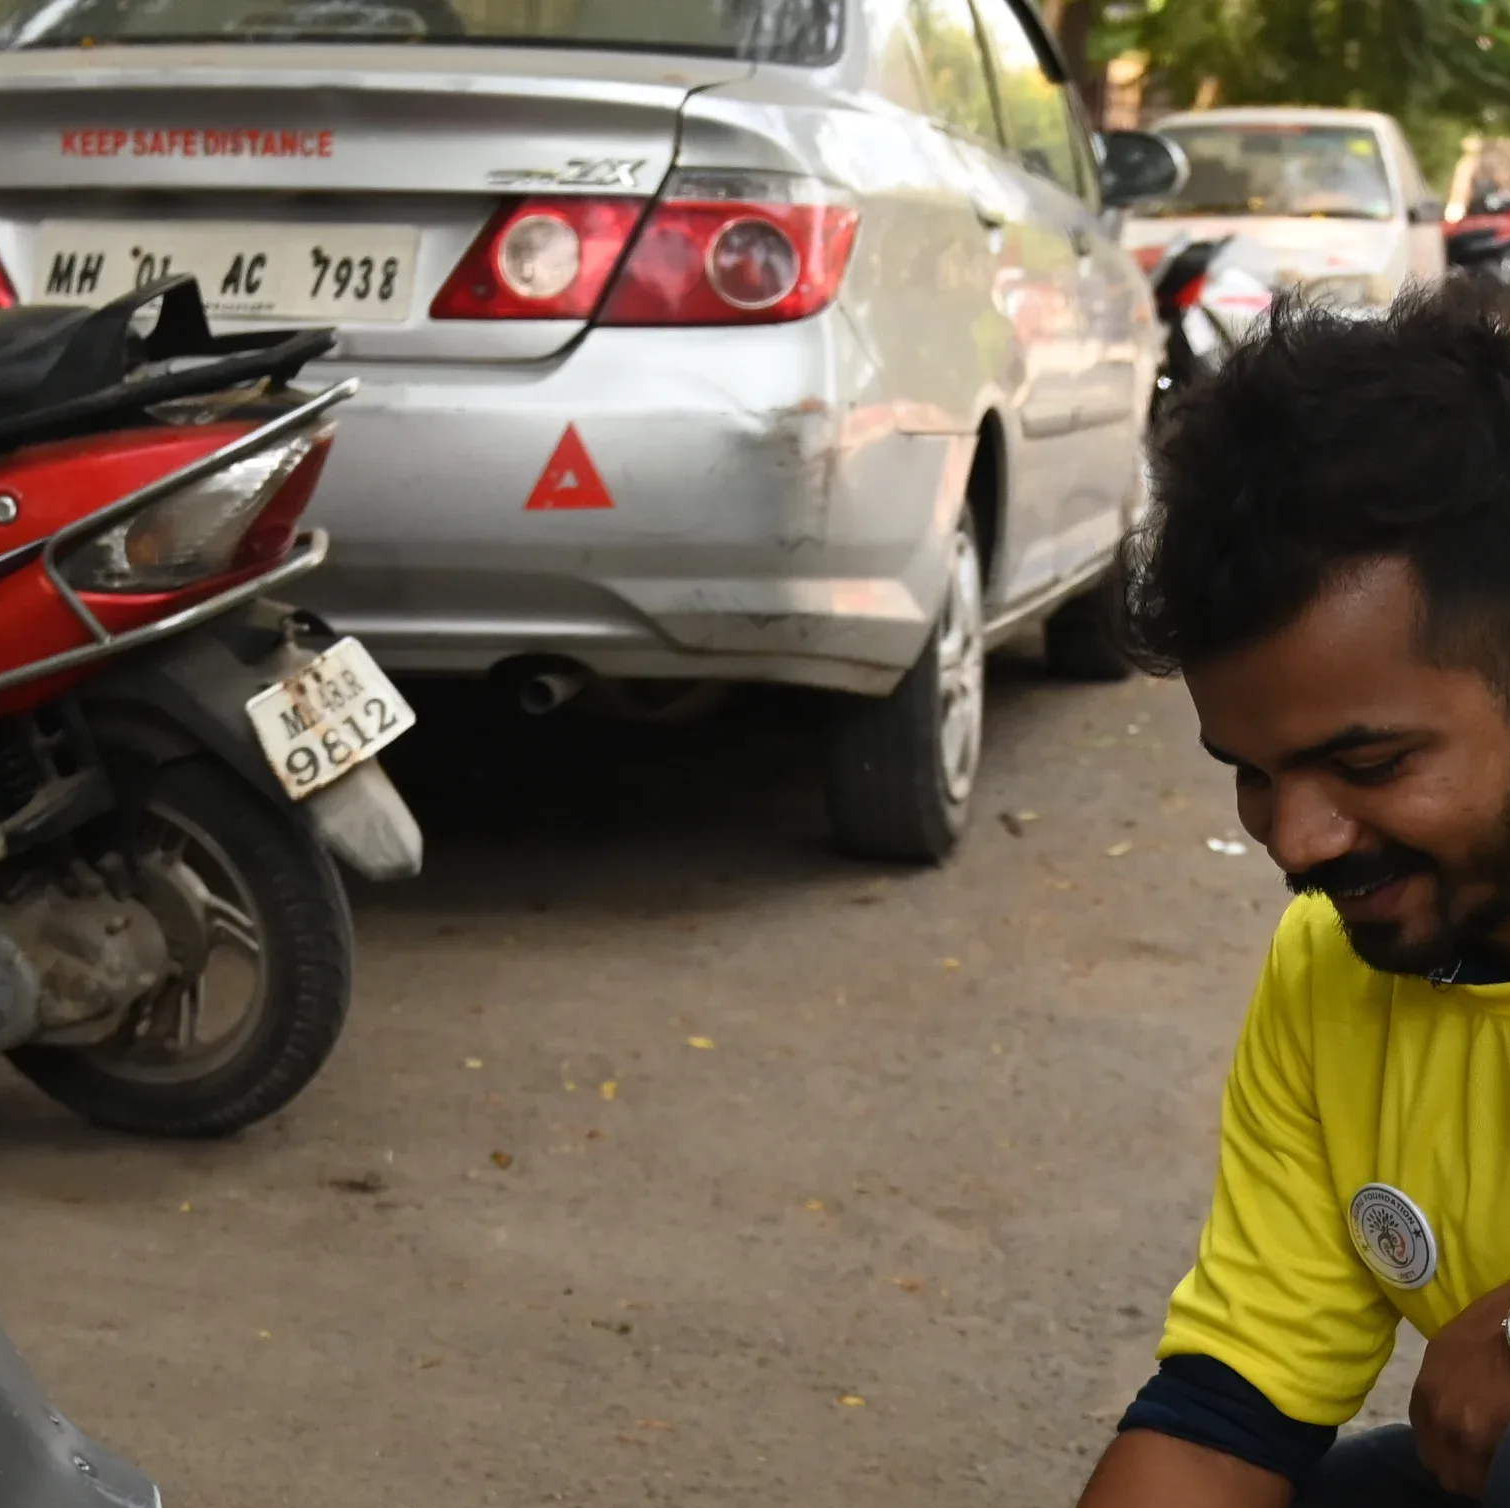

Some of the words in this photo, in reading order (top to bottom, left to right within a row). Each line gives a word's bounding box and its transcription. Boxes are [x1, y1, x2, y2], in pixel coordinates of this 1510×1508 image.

[61, 130, 128, 157] KEEP
[131, 130, 198, 157] SAFE
[202, 130, 334, 157] DISTANCE
[46, 251, 105, 296] MH
[221, 252, 267, 295] AC
[310, 248, 399, 300] 7938
[286, 698, 397, 786] 9812
